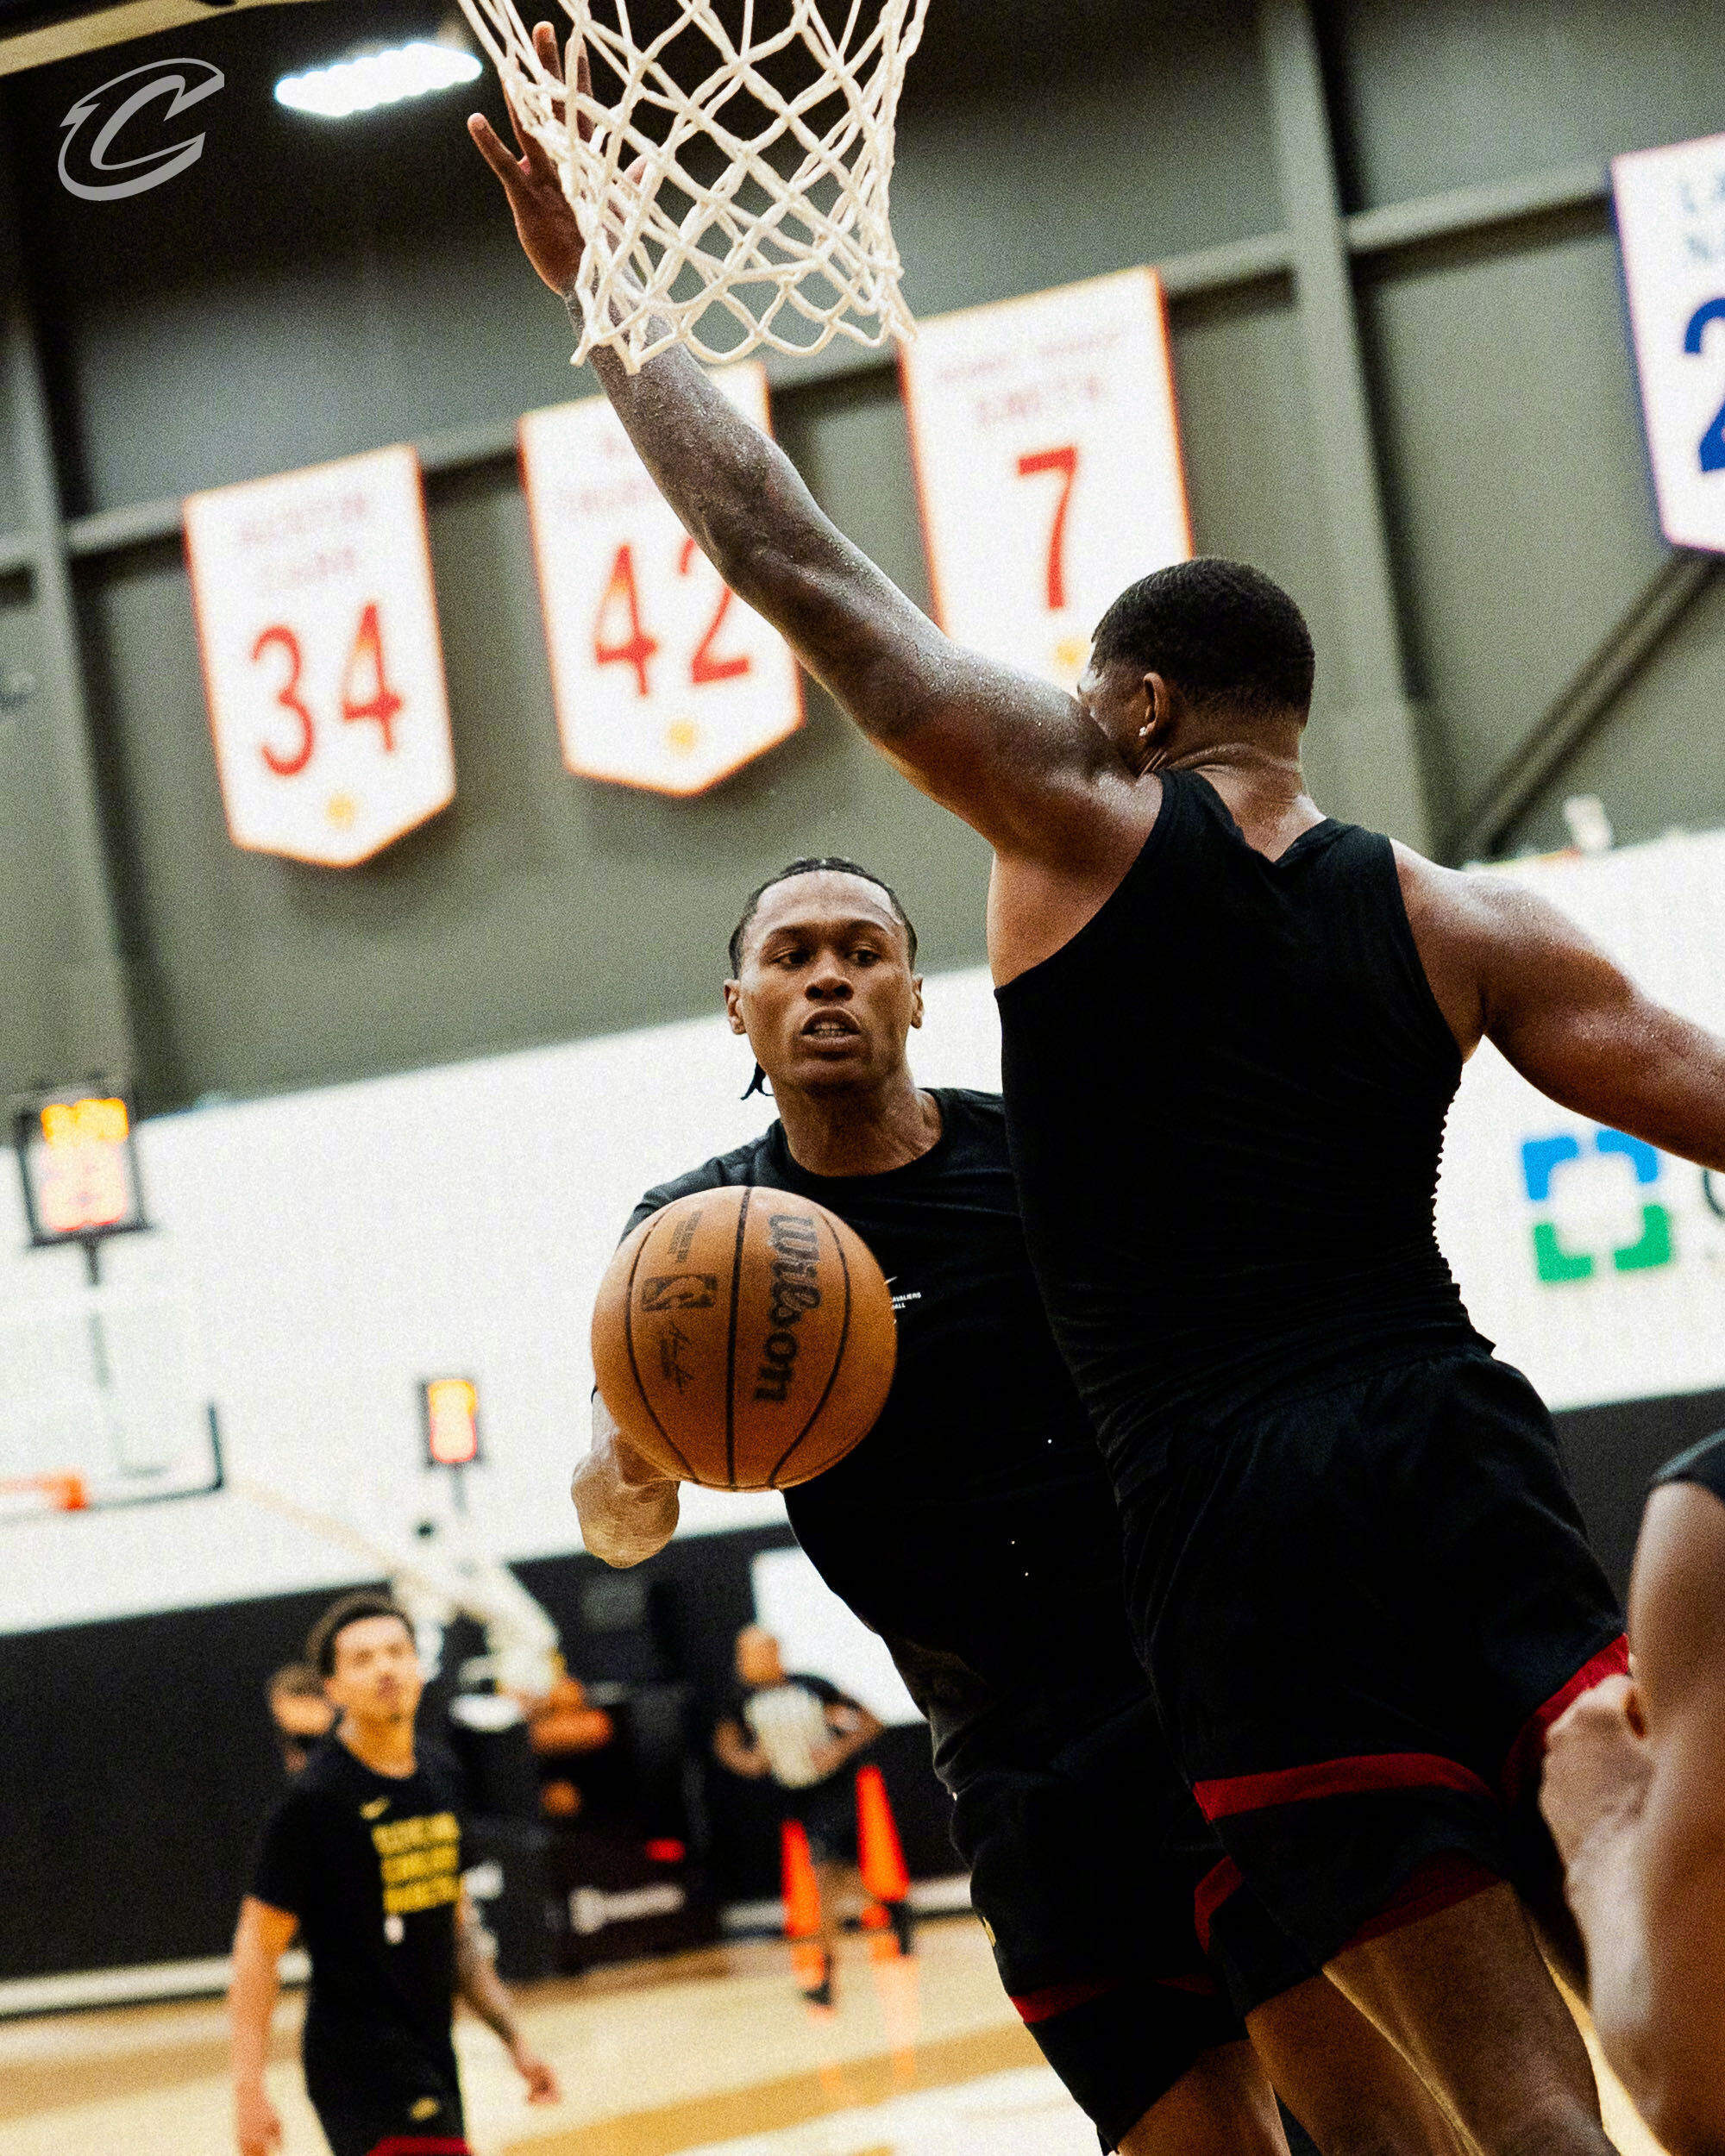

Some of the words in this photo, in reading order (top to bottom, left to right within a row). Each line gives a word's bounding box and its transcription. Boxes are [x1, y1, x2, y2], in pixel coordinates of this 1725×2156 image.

[1018, 446, 1078, 611] 7
[253, 602, 403, 776] 34
[594, 536, 750, 696] 42
[756, 1214, 821, 1401] Wilson
[892, 1292, 922, 1302] AVALIERS
